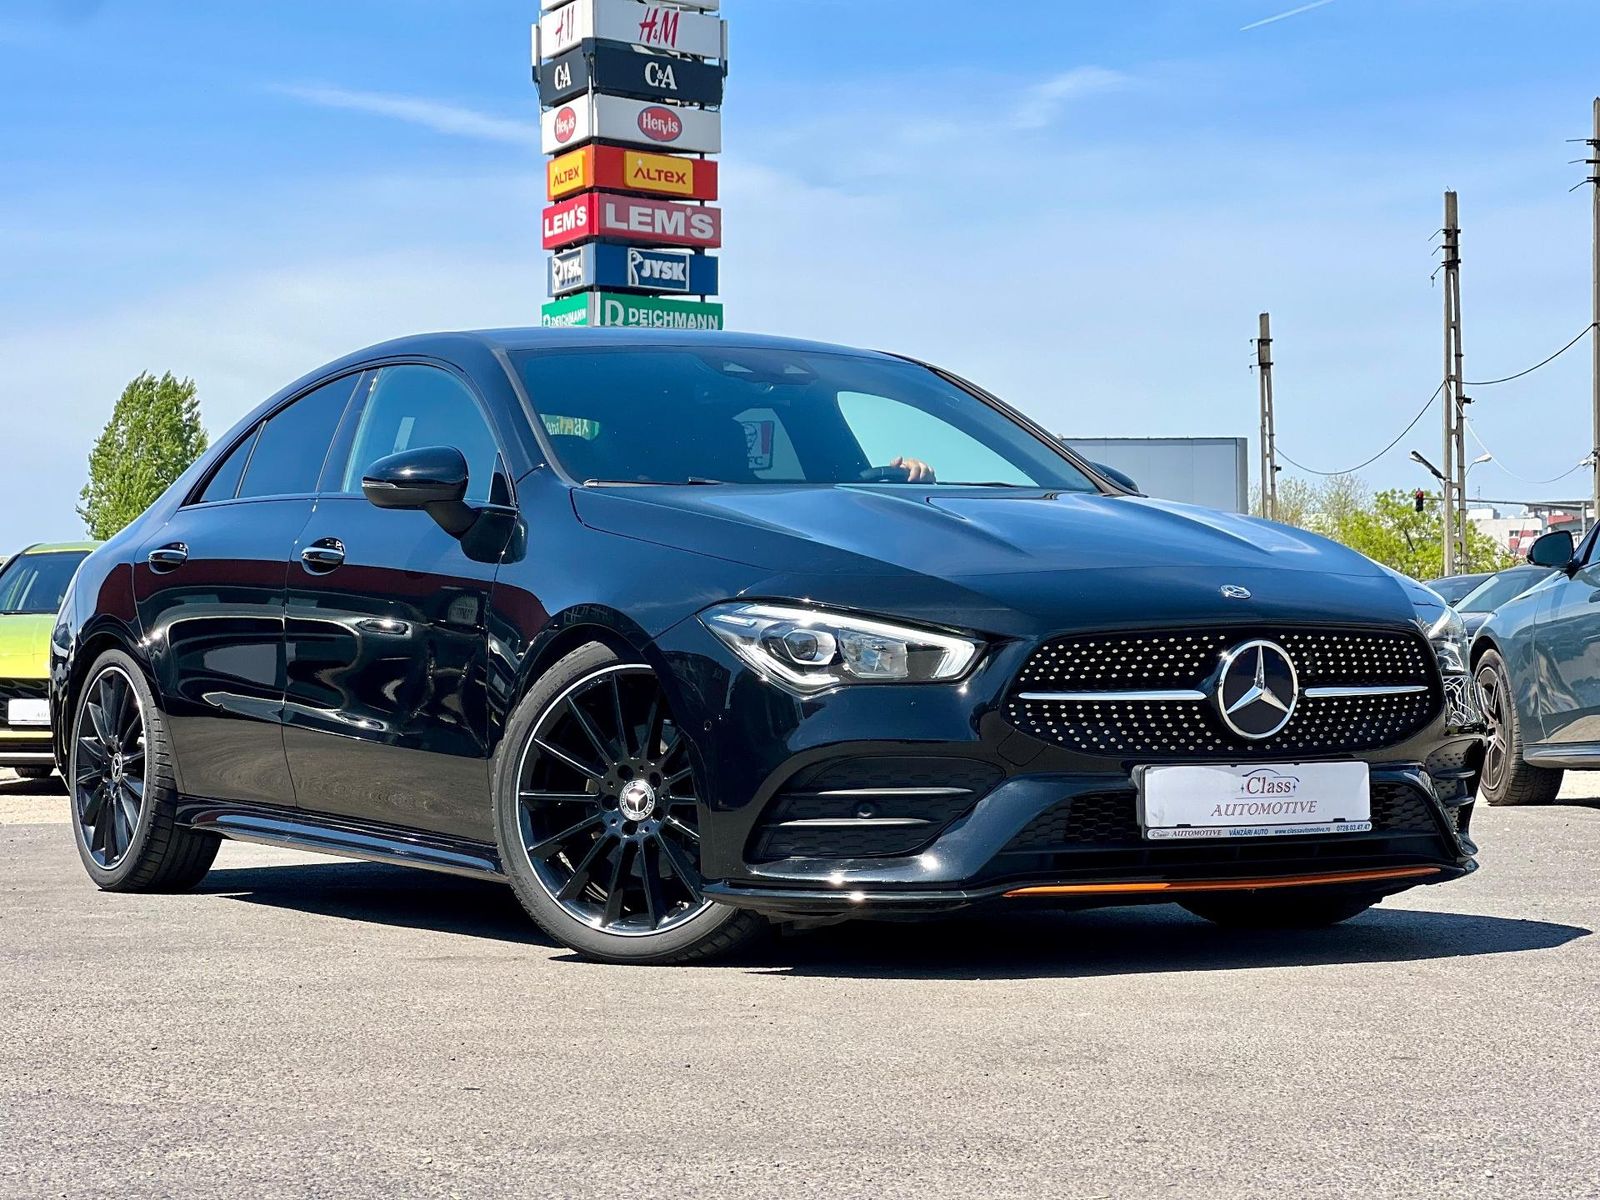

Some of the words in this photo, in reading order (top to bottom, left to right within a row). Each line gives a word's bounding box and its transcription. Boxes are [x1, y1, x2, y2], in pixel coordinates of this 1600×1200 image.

[639, 7, 680, 48] H&M
[644, 61, 678, 90] C&A
[642, 113, 679, 135] Hervis
[544, 204, 587, 238] LEM'S
[605, 203, 714, 239] LEM'S
[641, 259, 686, 281] JYSK
[628, 307, 719, 329] DEICHMANN
[1247, 776, 1291, 795] Class
[1211, 800, 1318, 816] AUTOMOTIVE
[1172, 828, 1222, 837] AUTOMOTIVE
